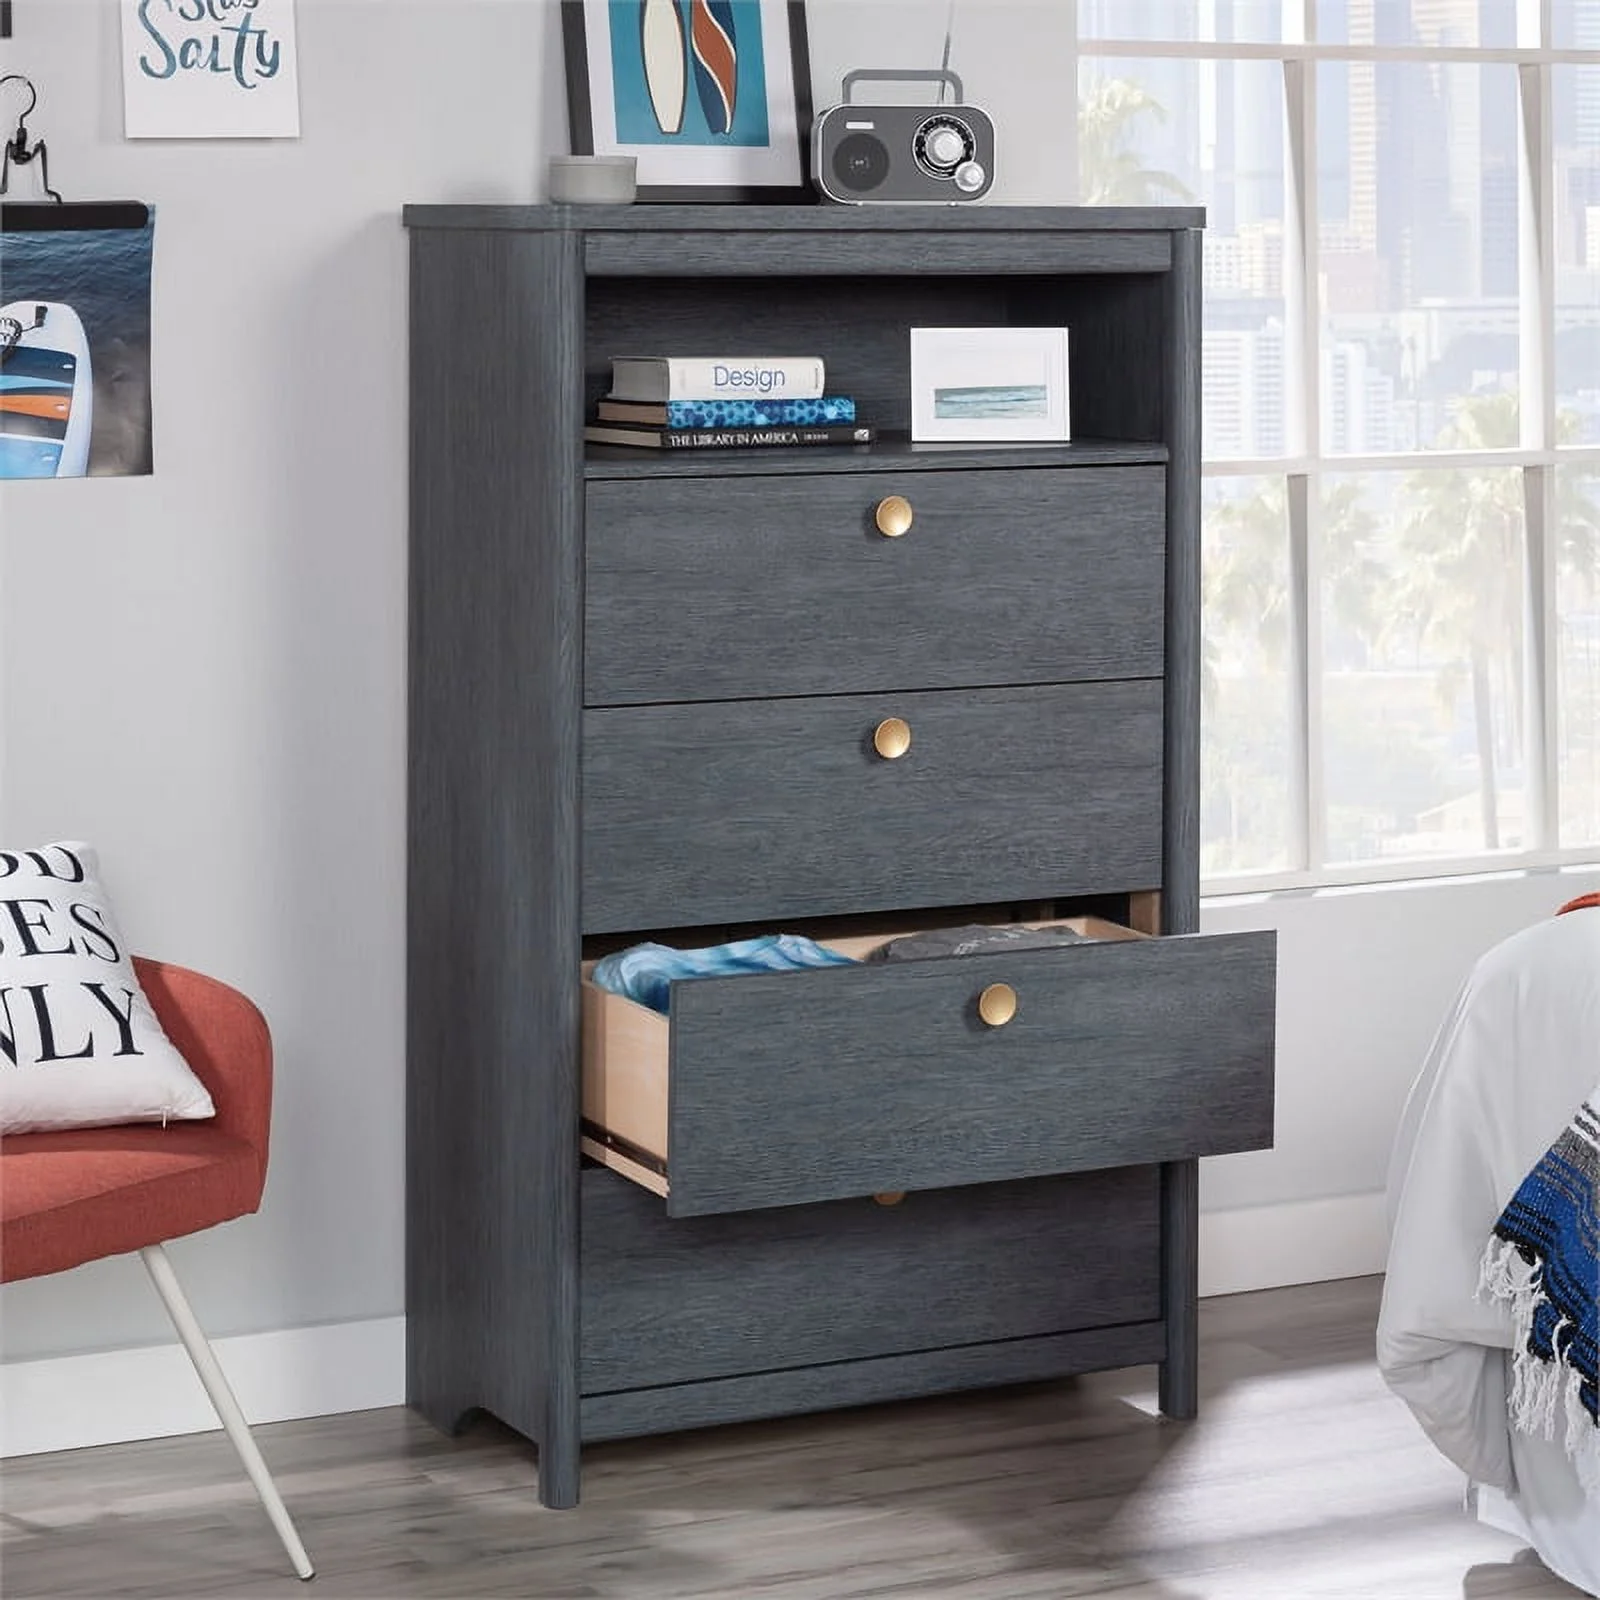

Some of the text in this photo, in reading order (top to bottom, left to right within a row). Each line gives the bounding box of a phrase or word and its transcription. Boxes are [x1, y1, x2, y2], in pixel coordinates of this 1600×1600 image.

[714, 366, 786, 392] Design
[751, 432, 799, 446] AMERICA
[0, 899, 120, 963] ES
